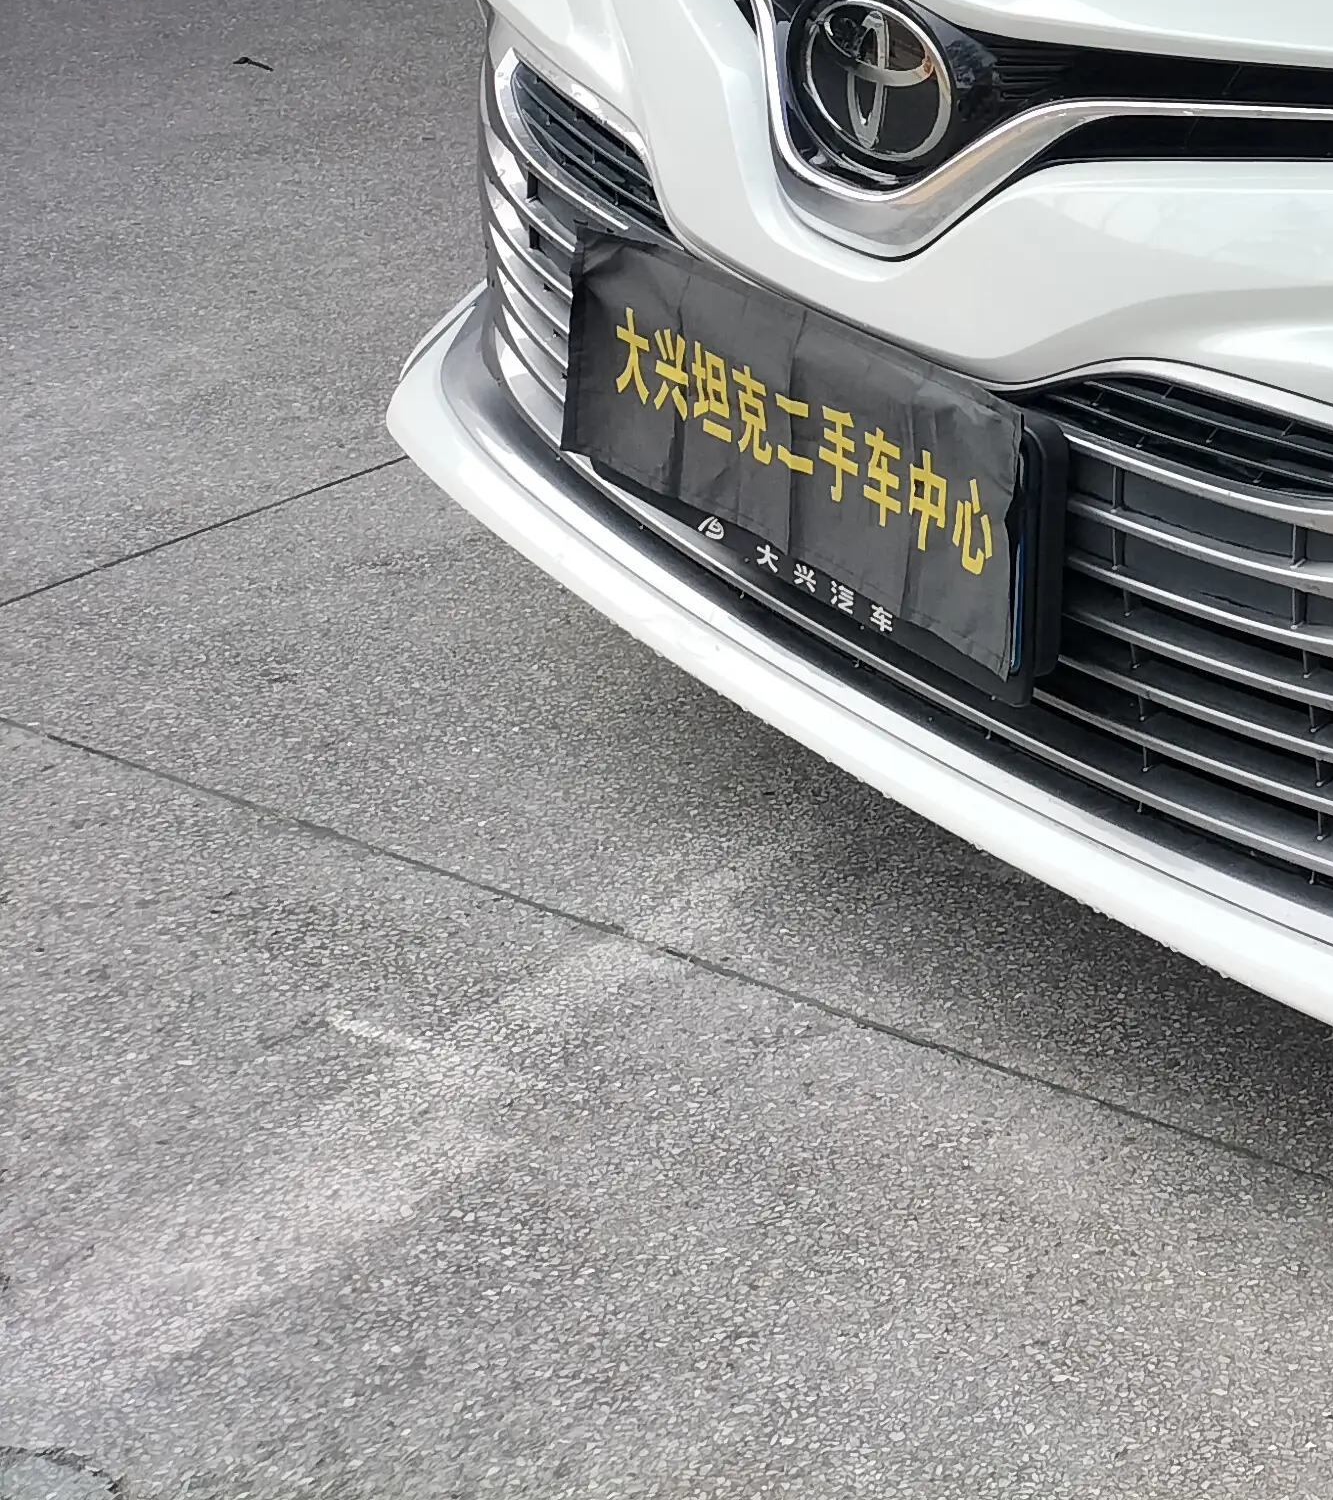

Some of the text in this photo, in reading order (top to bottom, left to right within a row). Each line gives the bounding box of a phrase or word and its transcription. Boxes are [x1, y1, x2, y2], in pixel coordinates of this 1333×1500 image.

[614, 307, 994, 576] 大兴坦克二手车中心
[755, 544, 895, 633] 大兴汽车
